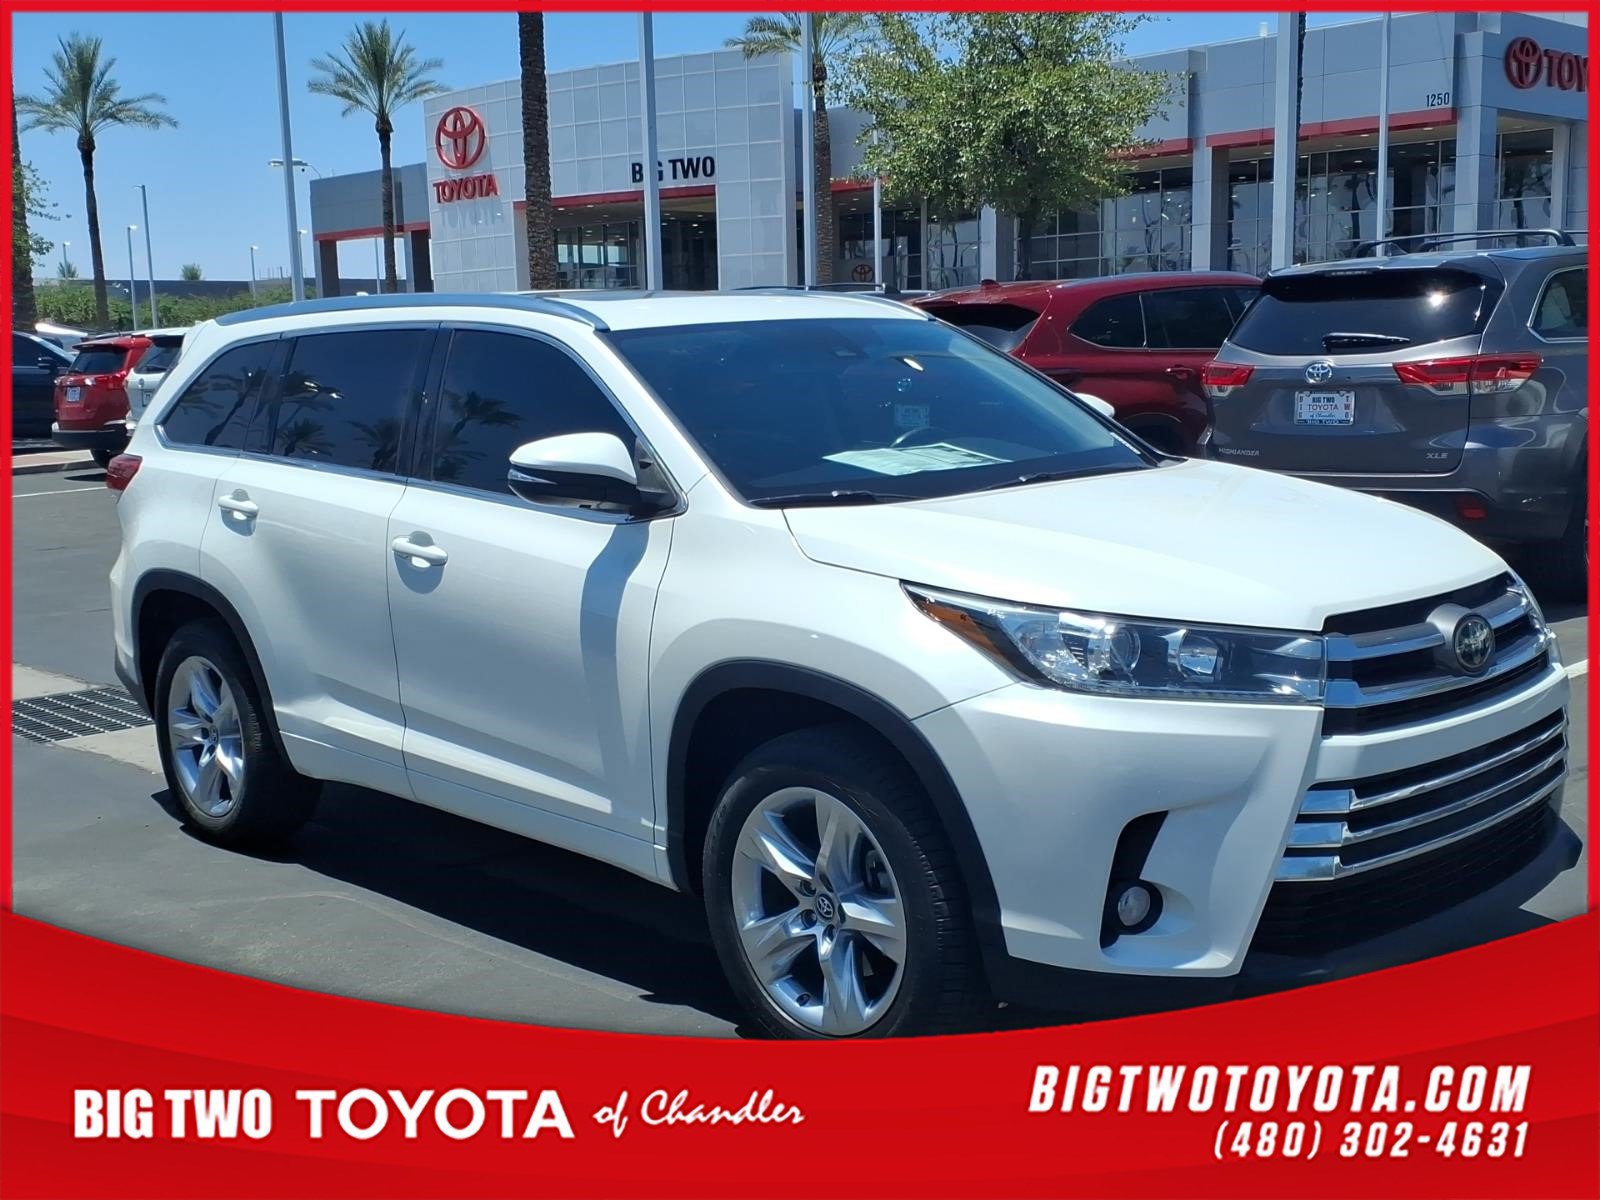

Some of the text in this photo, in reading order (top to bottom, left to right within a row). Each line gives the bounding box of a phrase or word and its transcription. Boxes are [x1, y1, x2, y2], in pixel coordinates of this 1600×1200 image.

[1426, 92, 1450, 107] 1250
[668, 156, 715, 180] TWO
[432, 174, 498, 204] TOYOTA
[1308, 403, 1339, 411] TOYOTA
